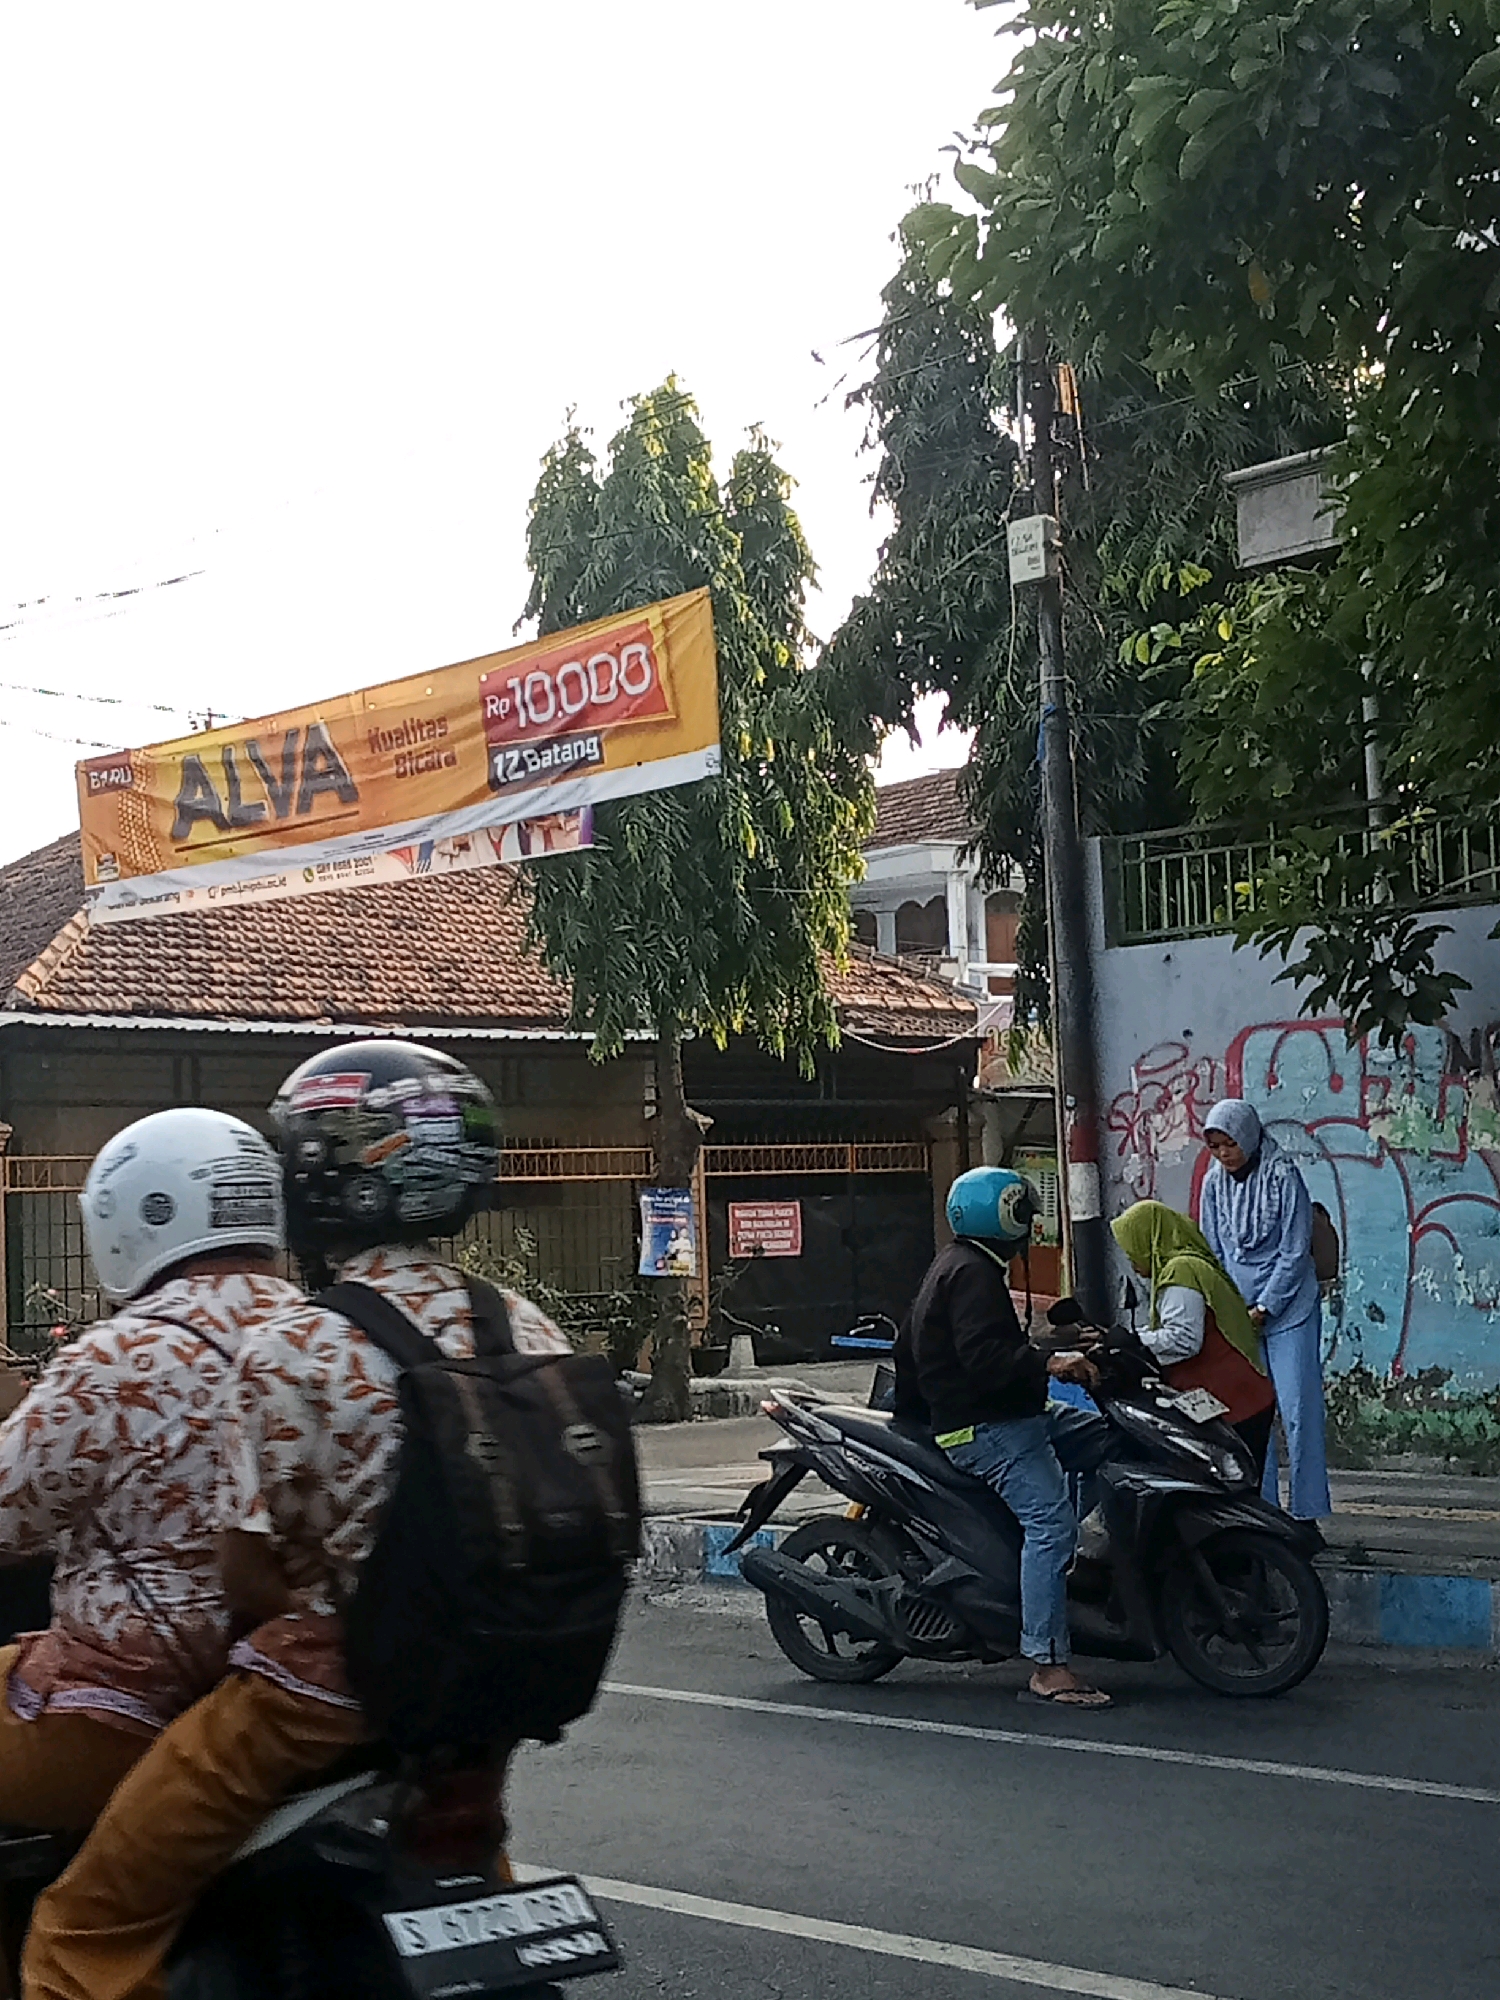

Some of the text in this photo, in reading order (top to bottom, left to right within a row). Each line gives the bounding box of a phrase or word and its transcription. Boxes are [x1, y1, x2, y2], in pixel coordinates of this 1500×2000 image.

[485, 643, 652, 728] Rp 10.000
[368, 716, 449, 754] Kualitas
[523, 736, 600, 772] Batang
[171, 722, 359, 841] ALVA
